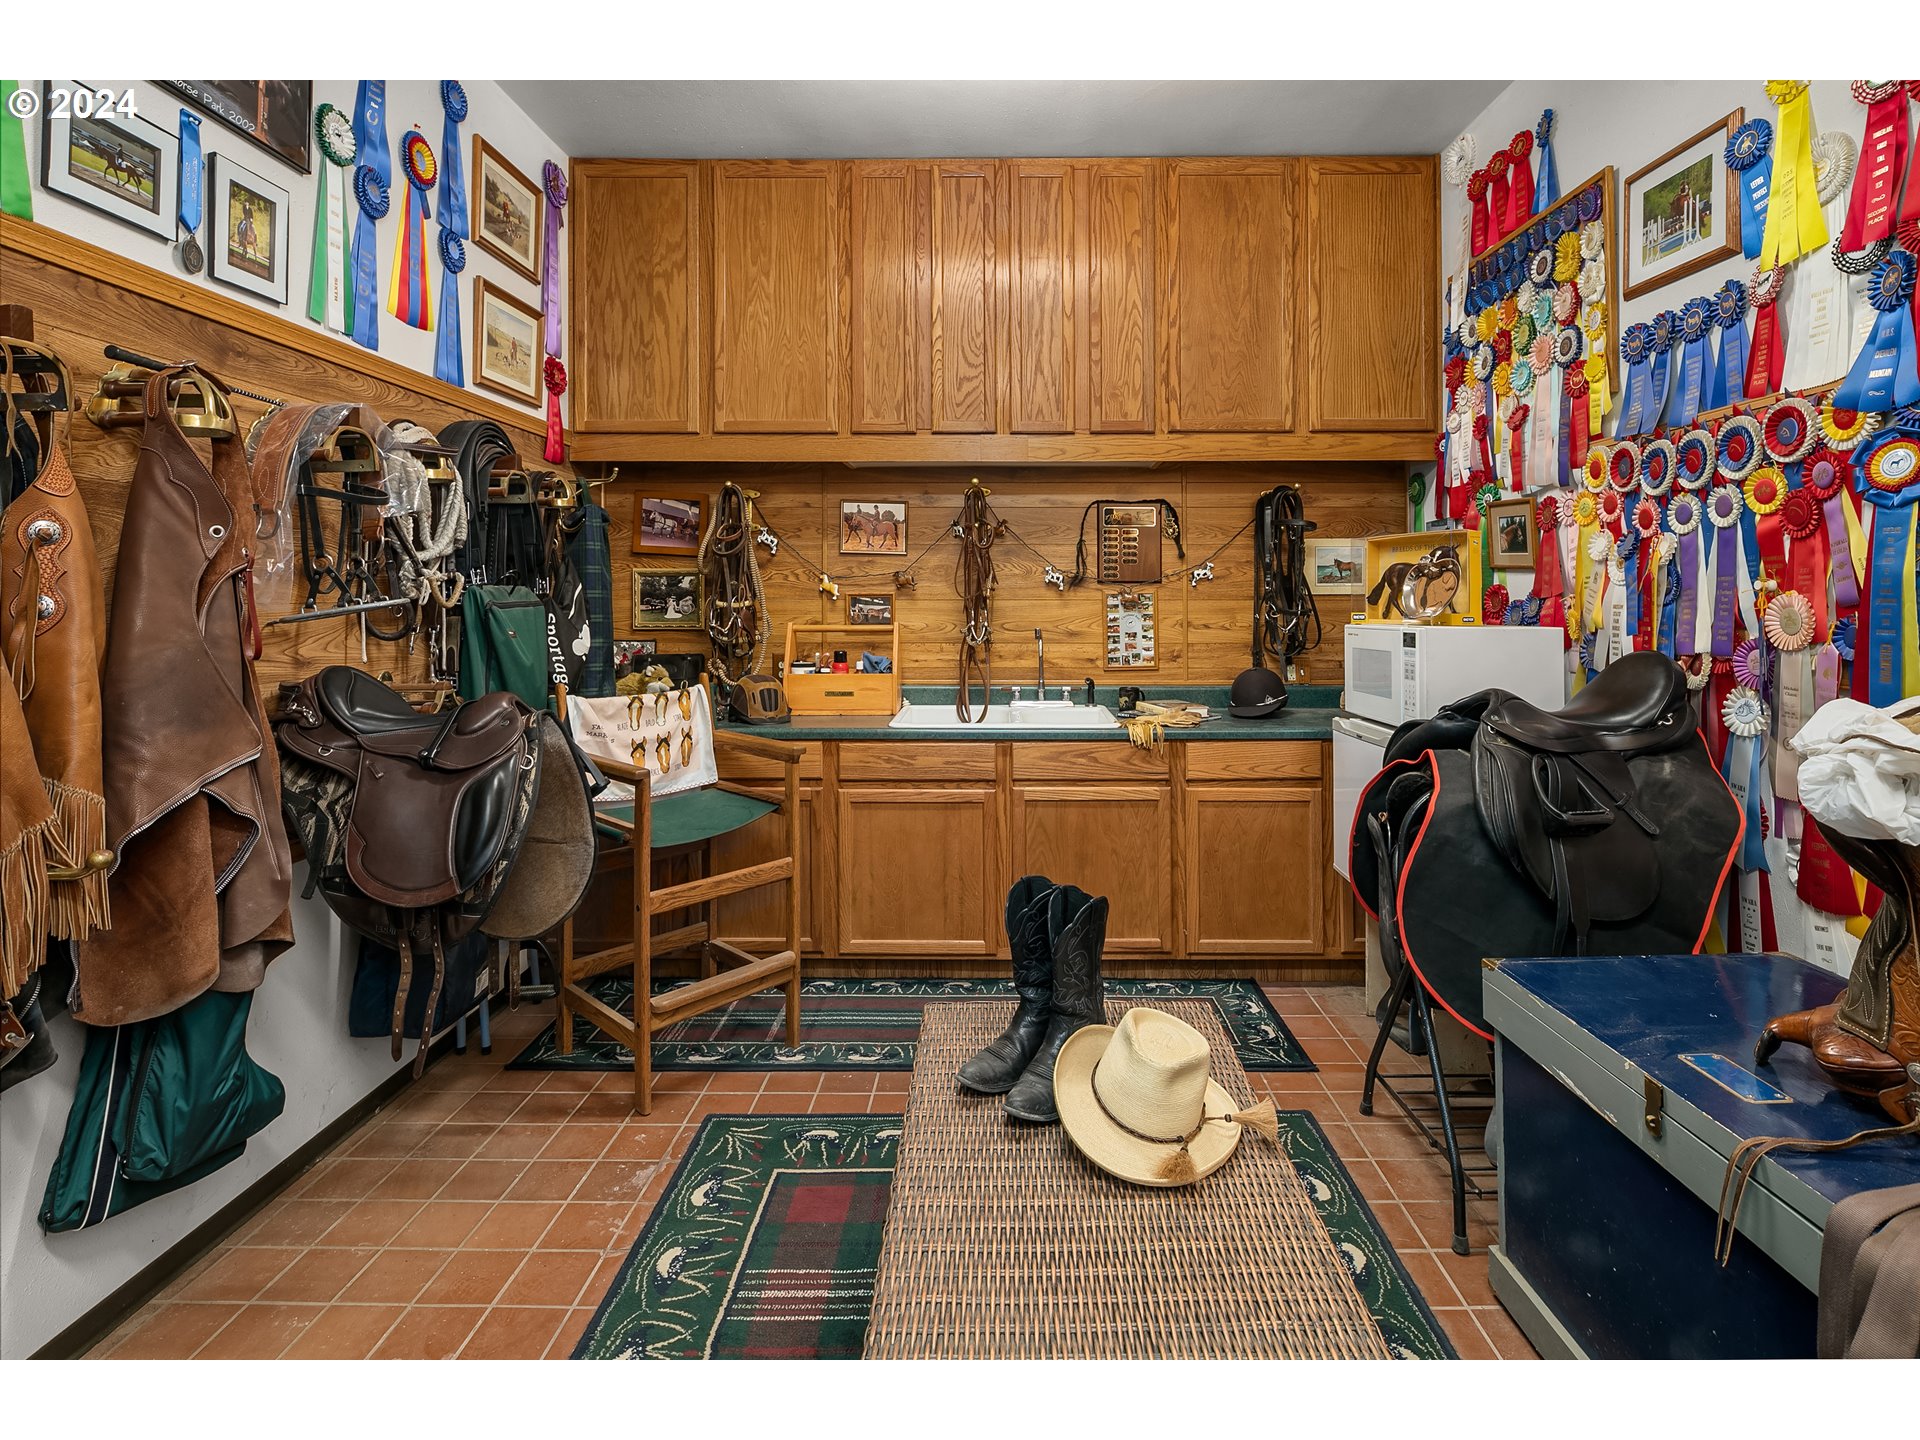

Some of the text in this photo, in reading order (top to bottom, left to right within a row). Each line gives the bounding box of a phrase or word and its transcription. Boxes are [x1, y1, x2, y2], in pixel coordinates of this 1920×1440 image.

[203, 92, 226, 116] Park
[229, 110, 256, 133] 2002
[1867, 206, 1888, 219] SECOND
[1867, 214, 1885, 226] PLACE
[1391, 545, 1413, 553] BREEDS
